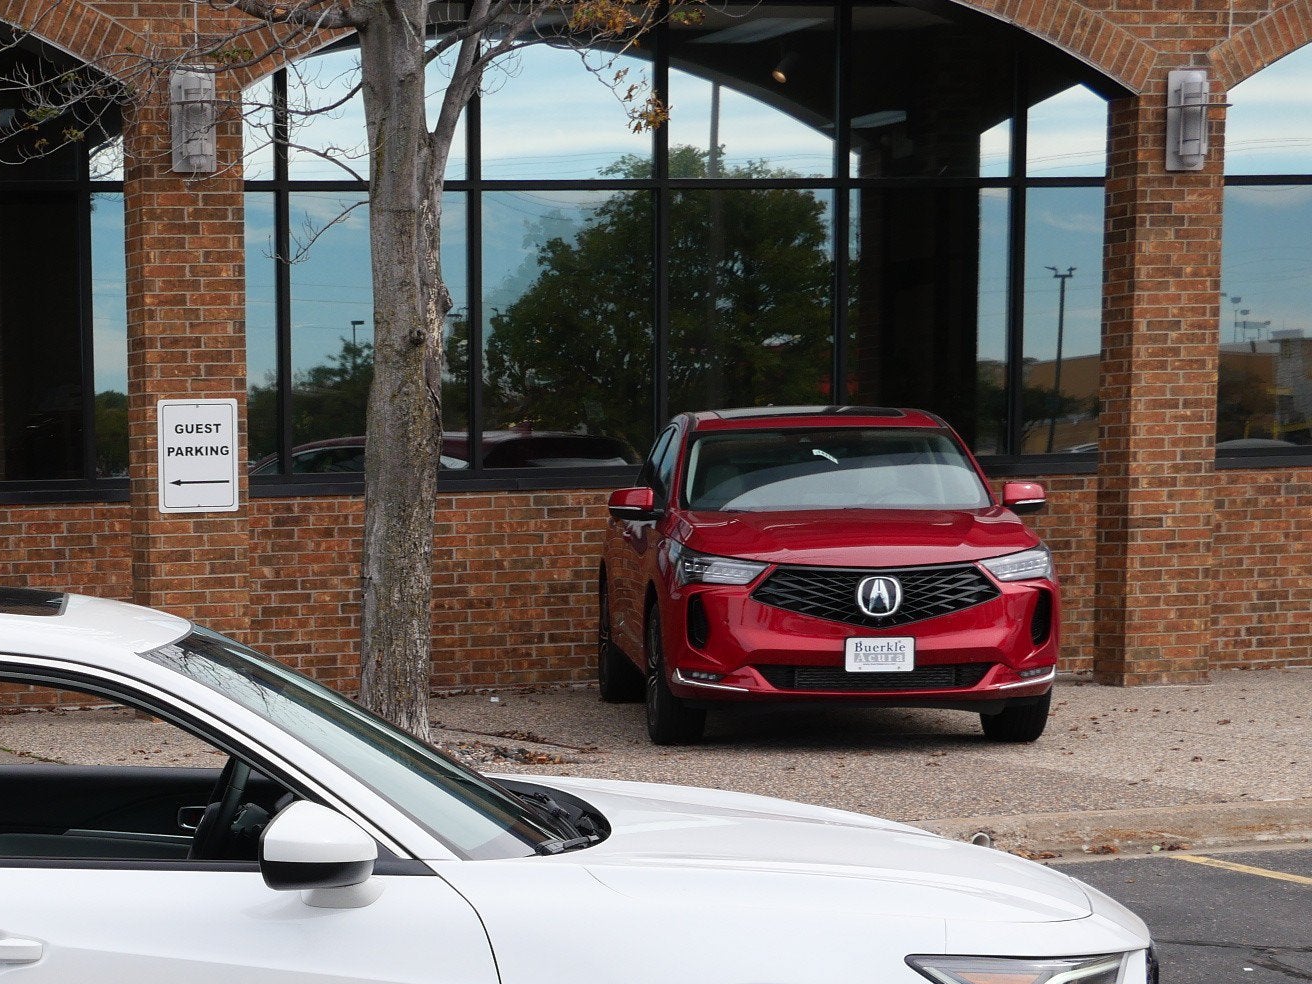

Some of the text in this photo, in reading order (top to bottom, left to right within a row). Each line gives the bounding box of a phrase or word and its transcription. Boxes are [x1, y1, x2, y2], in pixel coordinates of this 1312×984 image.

[174, 423, 221, 434] GUEST
[167, 445, 229, 457] PARKING
[854, 642, 906, 653] Buerkle
[856, 653, 904, 662] Acura
